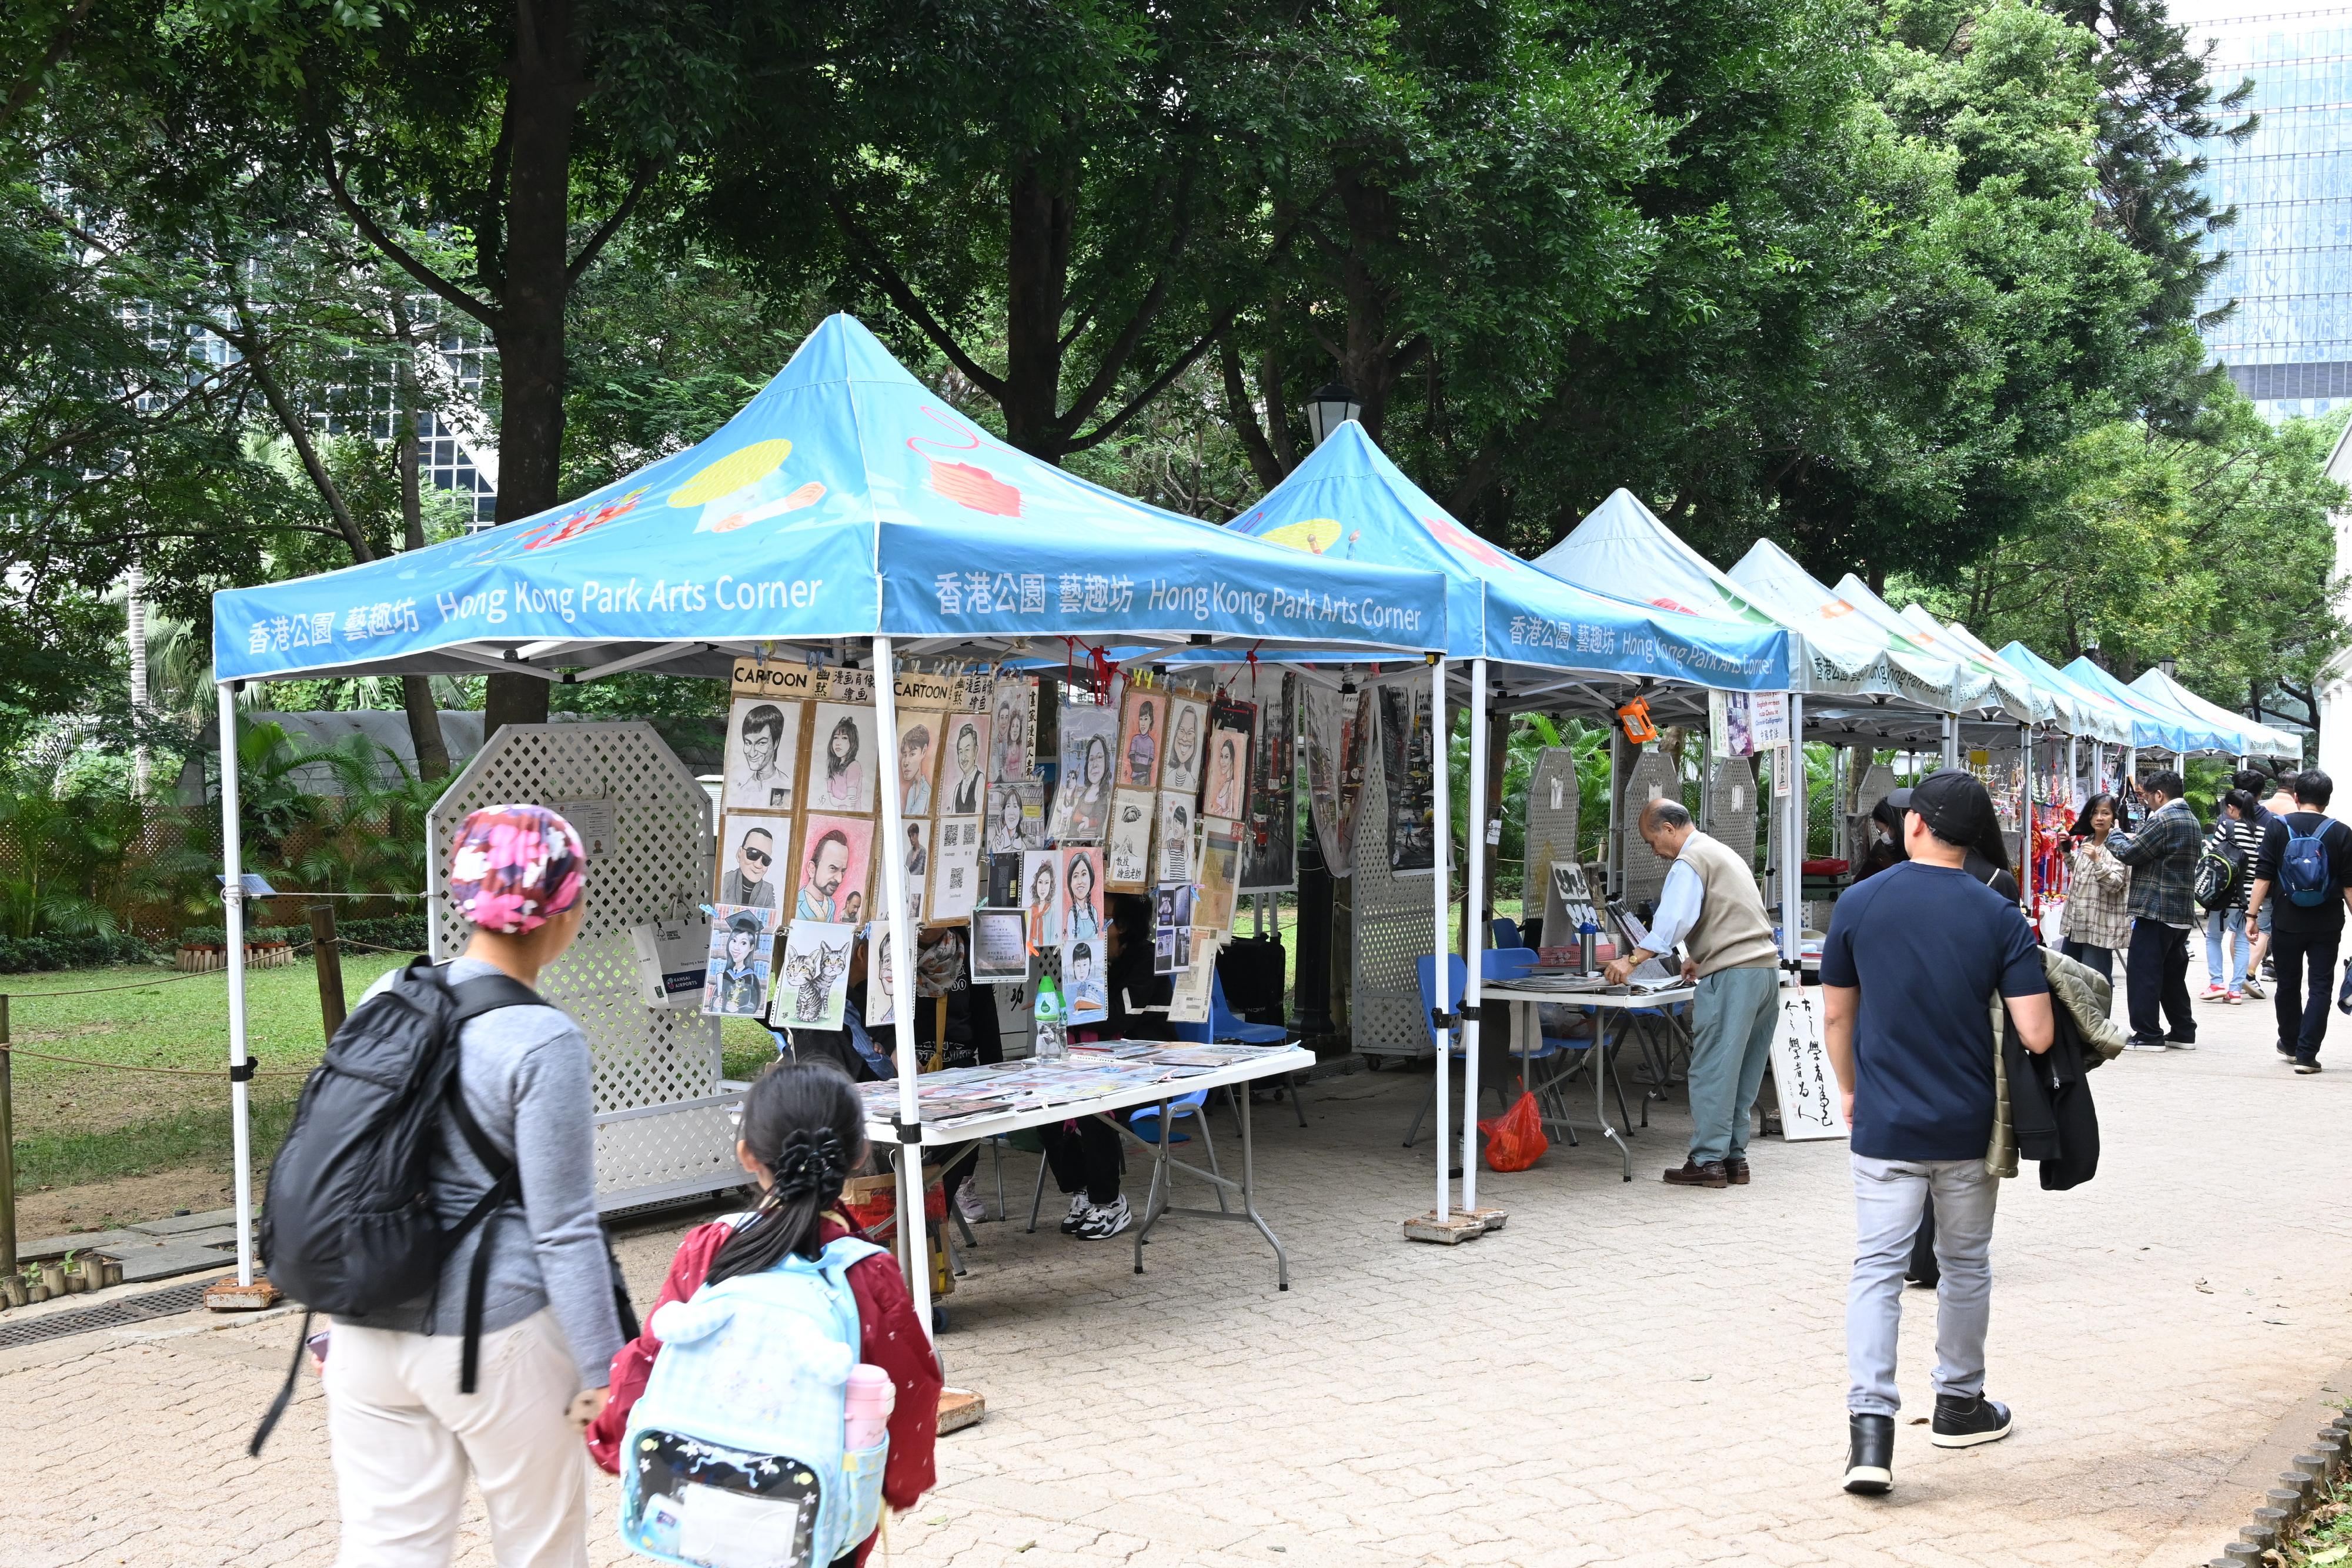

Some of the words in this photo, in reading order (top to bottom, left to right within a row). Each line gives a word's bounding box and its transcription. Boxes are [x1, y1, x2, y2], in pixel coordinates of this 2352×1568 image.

[934, 571, 1045, 615] 香港公園
[1059, 572, 1135, 614] 藝趣坊
[1148, 579, 1210, 621] Hong
[1213, 581, 1267, 624] Kong
[1270, 587, 1315, 620] Park
[1318, 593, 1358, 624] Arts
[1361, 597, 1422, 631] Corner
[248, 612, 336, 654] 香港公園
[343, 600, 419, 641] 藝趣坊
[436, 590, 508, 623] Hong
[514, 580, 574, 623] Kong
[582, 577, 642, 613] Park
[647, 579, 706, 613] Arts
[715, 574, 823, 611] Corner
[1509, 616, 1571, 651] 香港公園
[1576, 623, 1616, 655] 藝趣坊
[1622, 631, 1653, 664] Hong
[1653, 636, 1688, 670] Kong
[1688, 644, 1716, 669] Park
[1742, 653, 1775, 676] Corner
[734, 667, 807, 688] CARTOON
[893, 681, 948, 698] CARTOON
[2199, 879, 2210, 894] GOAL
[675, 980, 698, 988] AIRPORTS
